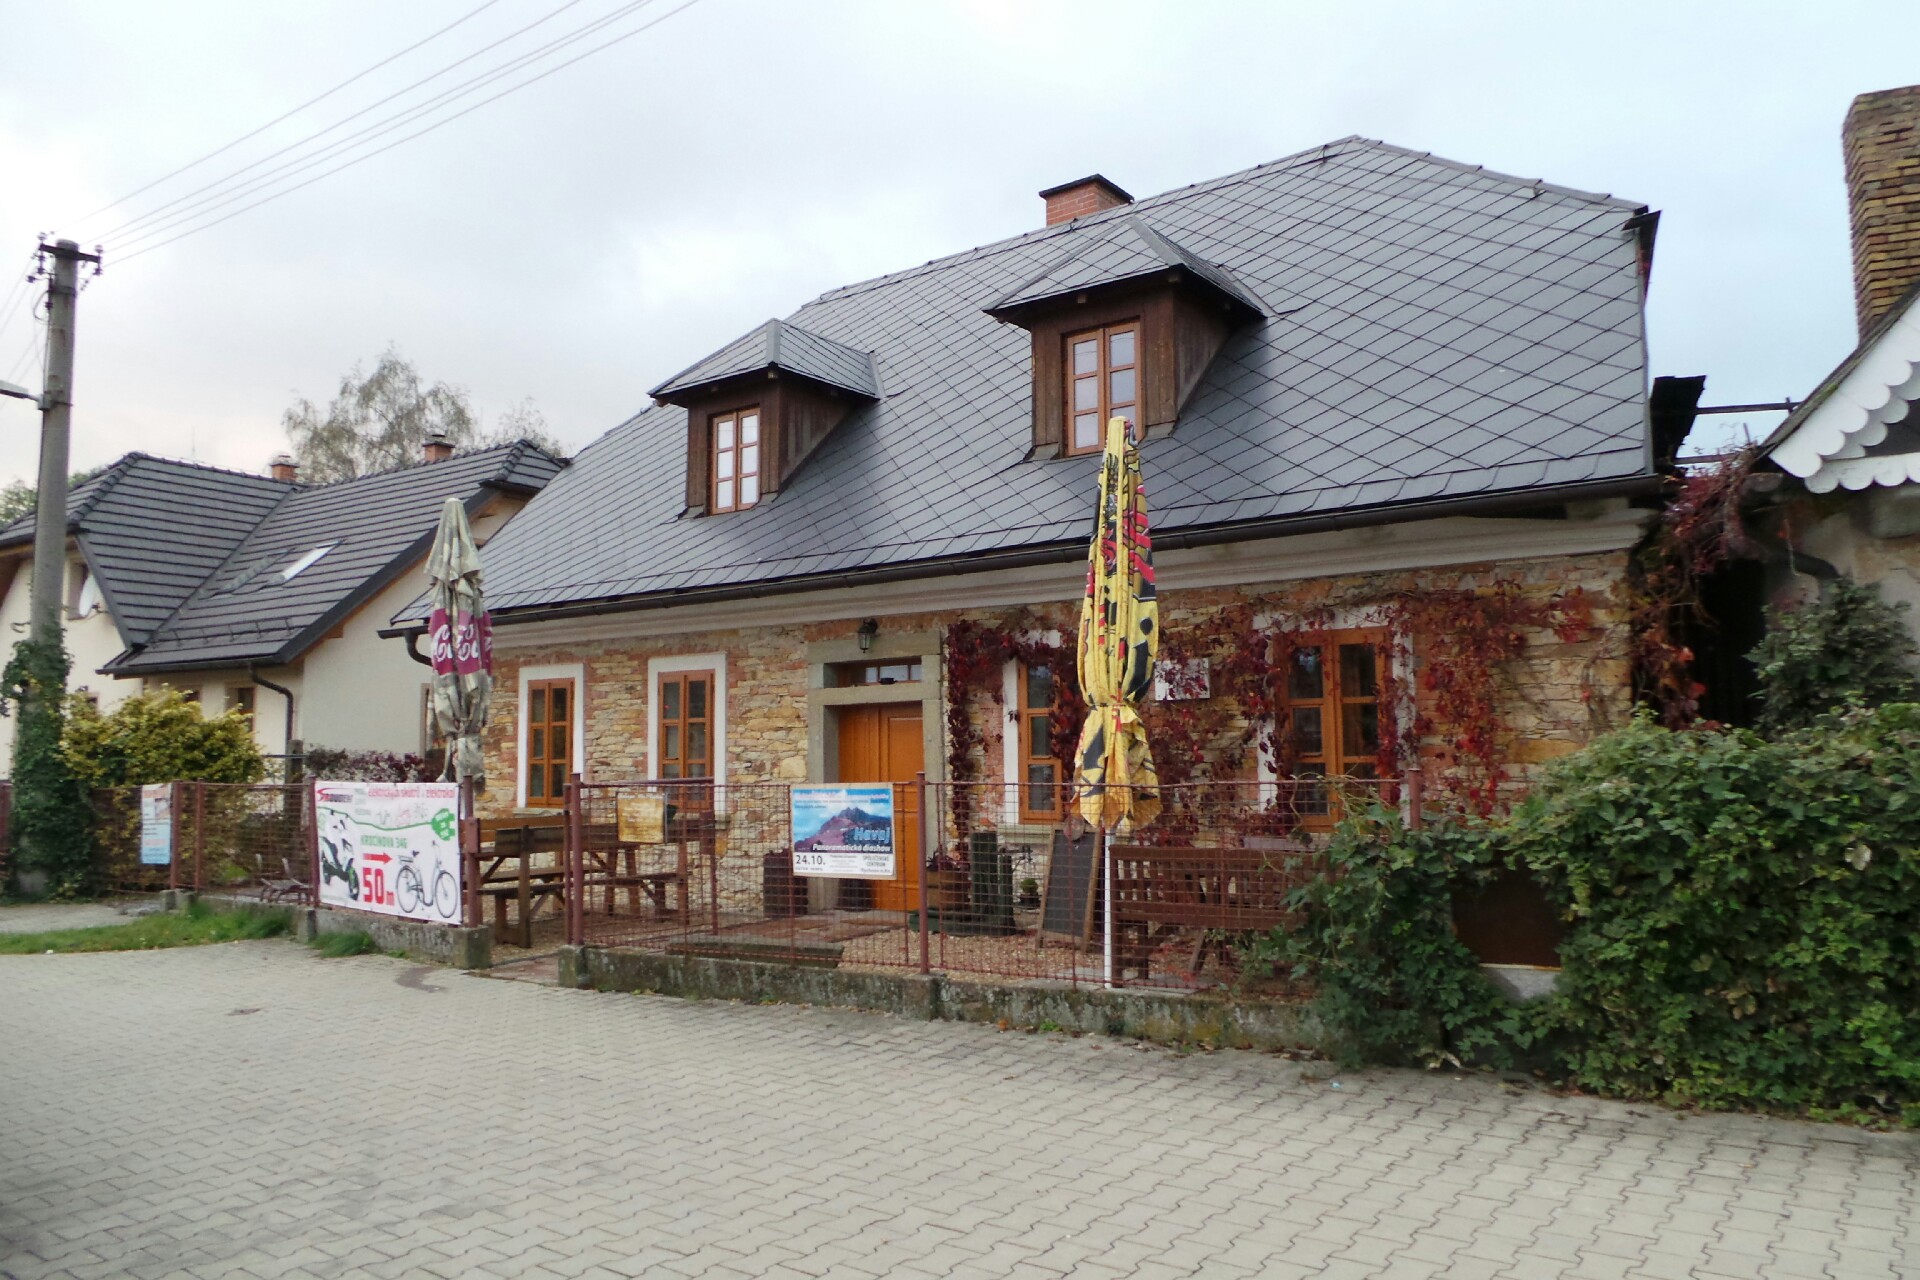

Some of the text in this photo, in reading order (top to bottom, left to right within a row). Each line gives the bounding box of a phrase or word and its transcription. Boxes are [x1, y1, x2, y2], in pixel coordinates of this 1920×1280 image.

[854, 826, 890, 844] Havaj
[863, 843, 891, 852] diashow
[795, 854, 826, 865] 24.10.
